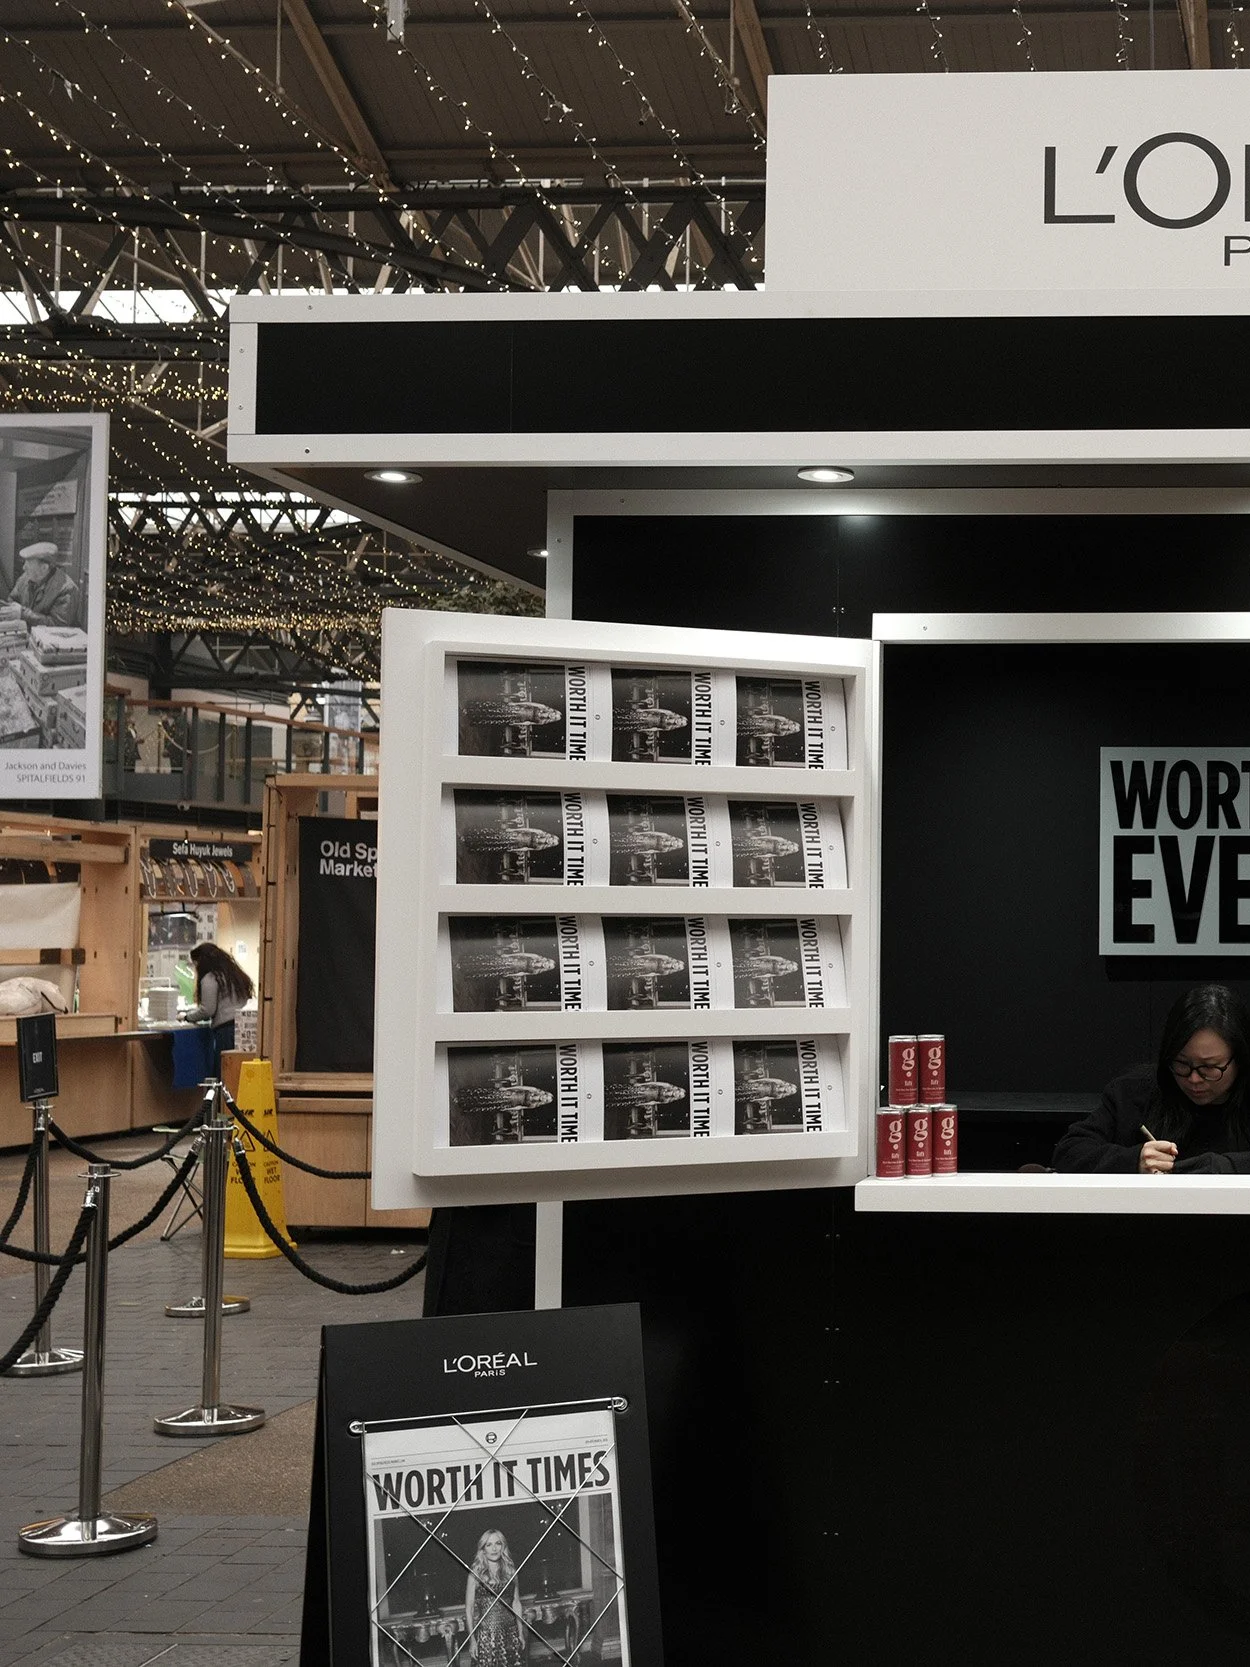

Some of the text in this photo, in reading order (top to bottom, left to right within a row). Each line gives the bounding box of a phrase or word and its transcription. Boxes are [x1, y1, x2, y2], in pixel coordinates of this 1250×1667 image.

[568, 666, 586, 761] WORTH IT TIME
[694, 672, 711, 765] WORTH IT TIME
[804, 681, 824, 770] WORTH IT TIME
[5, 762, 87, 770] Jackson and Davies
[16, 774, 86, 783] SPITALFIELDS 91
[320, 840, 351, 858] Old
[564, 793, 584, 886] WORTH IT TIME
[687, 797, 708, 887] WORTH IT TIME
[800, 803, 824, 888] WORTH IT TIME
[559, 916, 581, 1011] WORTH IT TIME
[688, 917, 710, 1010] WORTH IT TIME
[800, 919, 824, 1008] WORTH IT TIME
[559, 1044, 578, 1143] WORTH IT TIME
[691, 1041, 710, 1137] WORTH IT TIME
[800, 1040, 822, 1132] WORTH IT TIME
[443, 1352, 538, 1373] L'ORÉAL
[372, 1450, 611, 1511] WORTH IT TIMES
